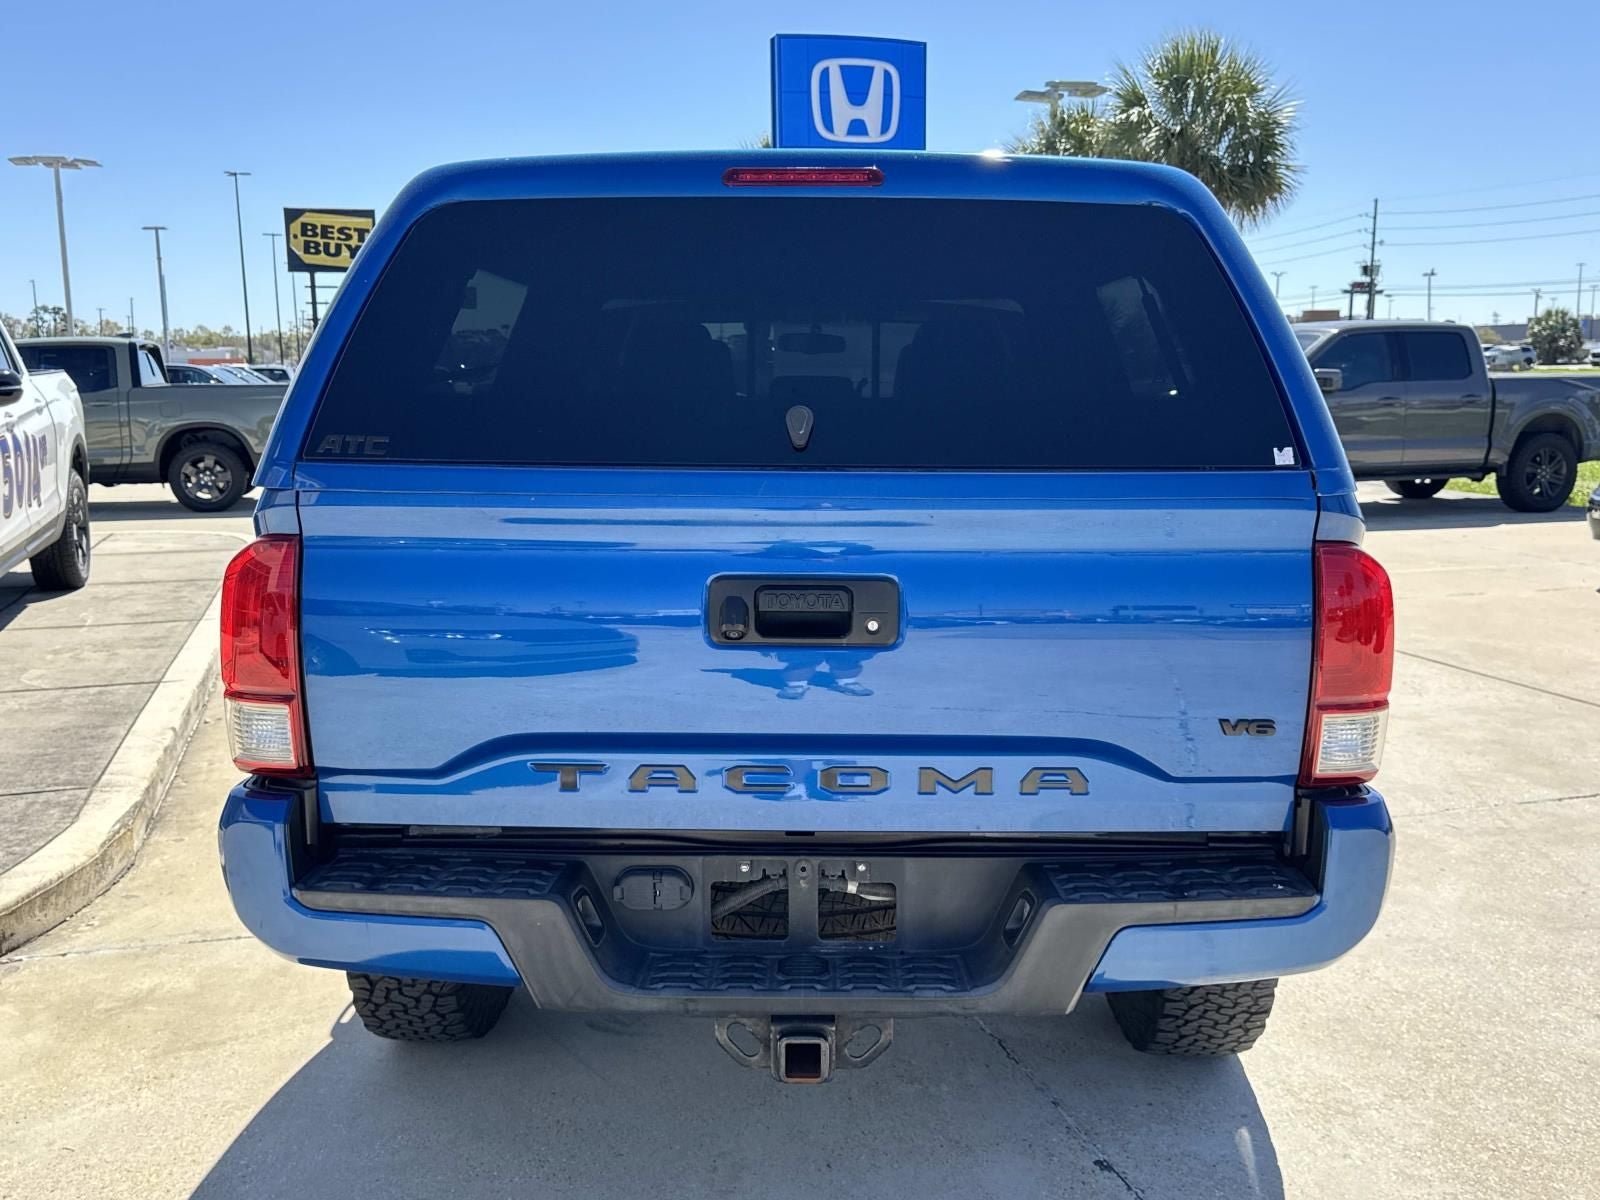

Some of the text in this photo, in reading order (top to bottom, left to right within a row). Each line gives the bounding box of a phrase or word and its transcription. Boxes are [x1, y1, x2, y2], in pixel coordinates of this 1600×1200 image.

[300, 222, 370, 243] BEST
[764, 592, 845, 610] TOYOTA
[1218, 718, 1276, 737] V6
[528, 761, 1090, 796] TACOMA
